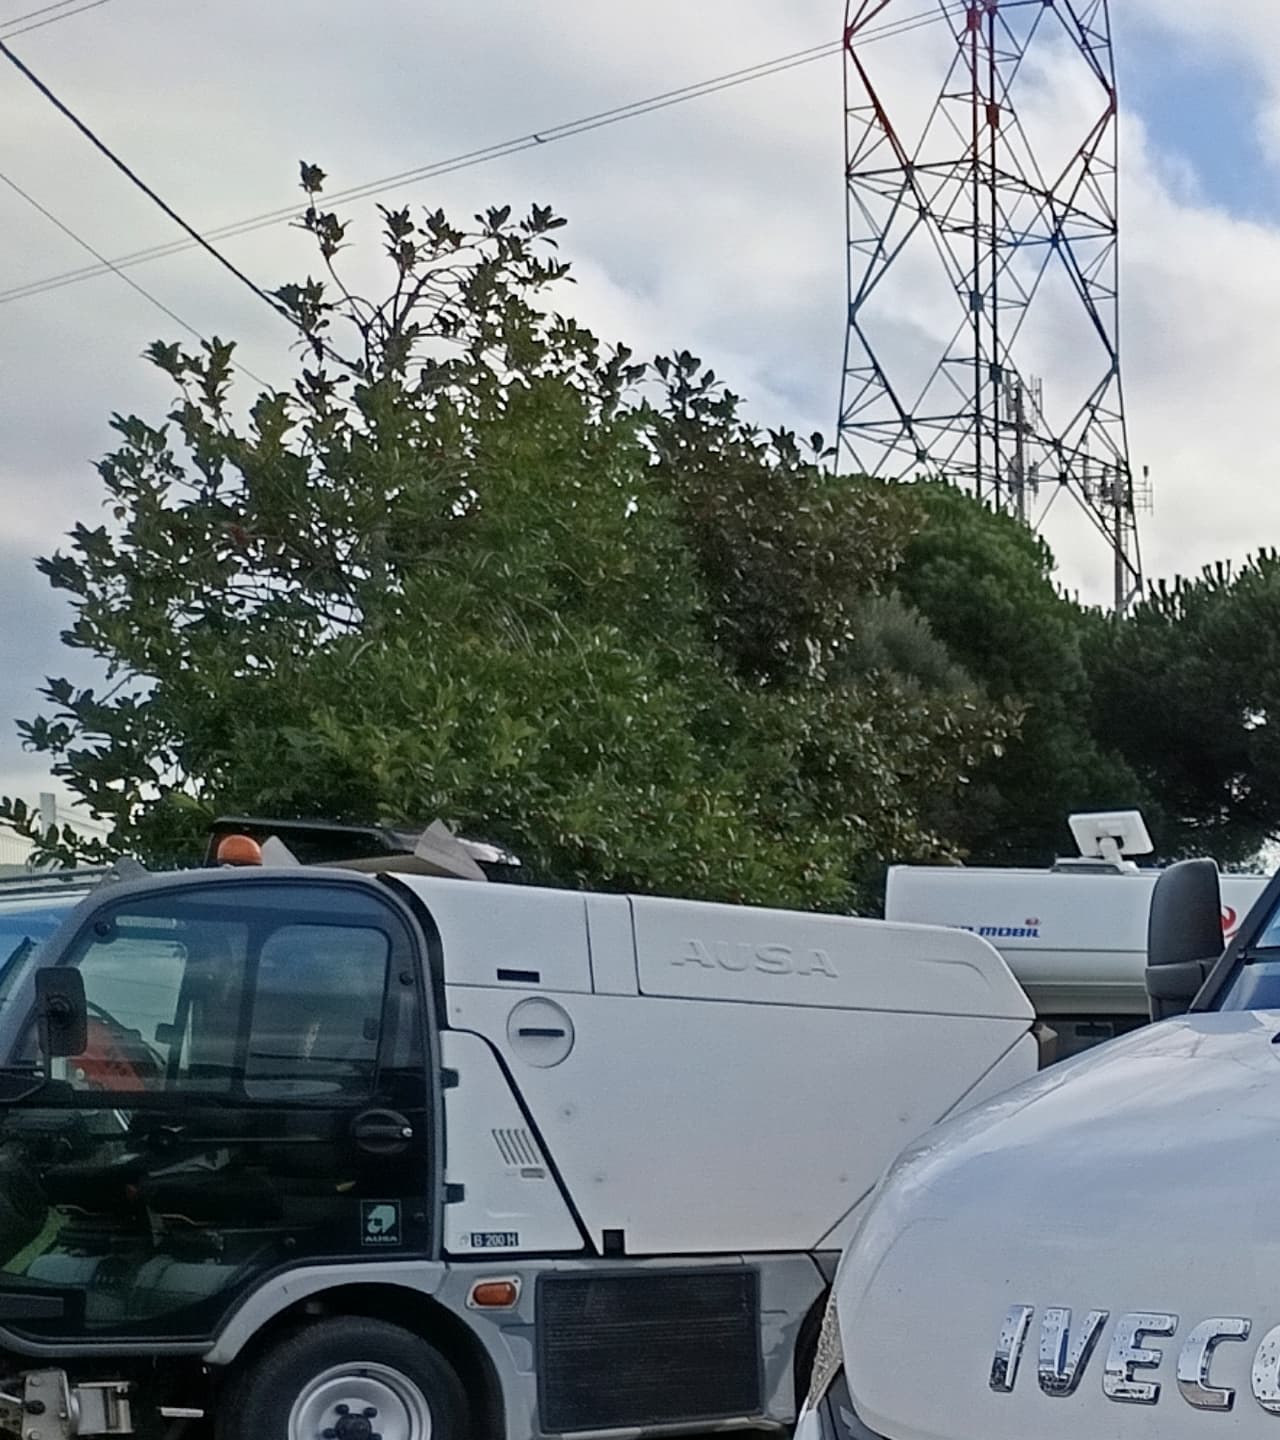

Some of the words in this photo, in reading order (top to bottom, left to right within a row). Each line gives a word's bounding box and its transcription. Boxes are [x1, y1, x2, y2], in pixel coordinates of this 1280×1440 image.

[979, 926, 1040, 938] MOBIL
[671, 938, 840, 979] AUSA
[474, 1234, 482, 1246] B
[484, 1234, 506, 1246] 200
